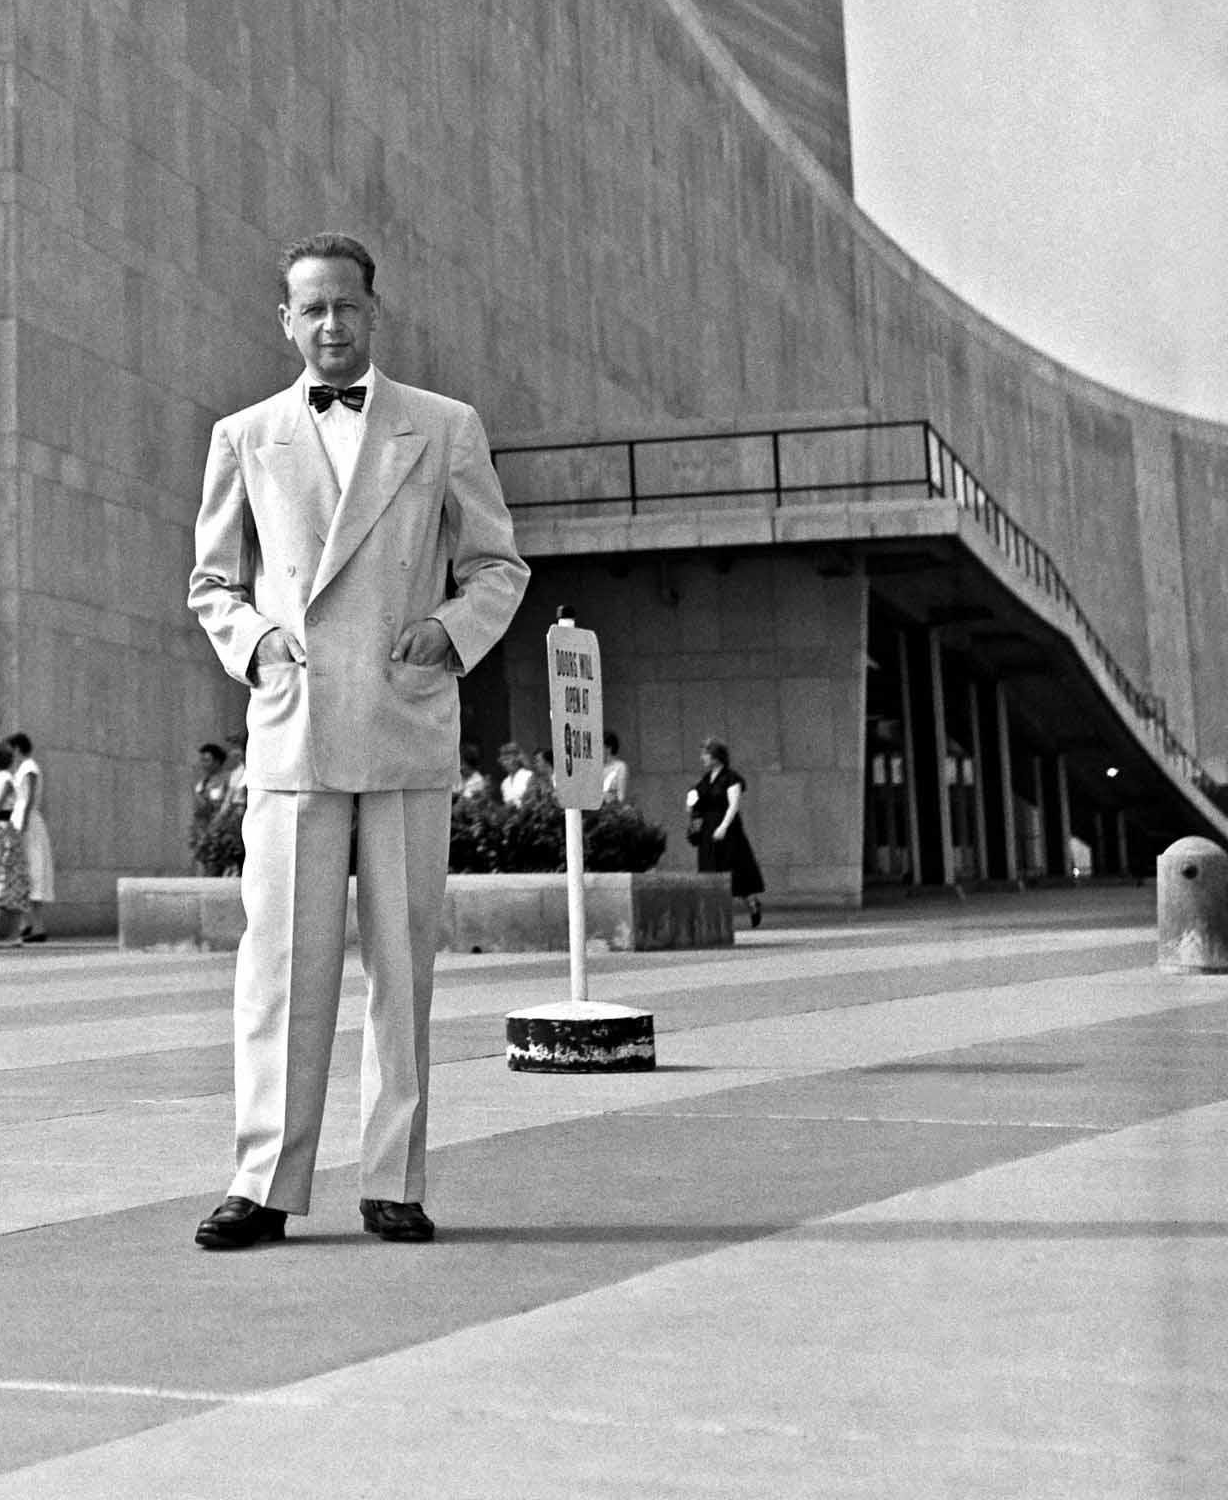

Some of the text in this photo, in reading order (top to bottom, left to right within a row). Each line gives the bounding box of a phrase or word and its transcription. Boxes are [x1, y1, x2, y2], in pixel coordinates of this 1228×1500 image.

[556, 649, 594, 680] DOORS WILL
[565, 686, 589, 715] OPEN AT
